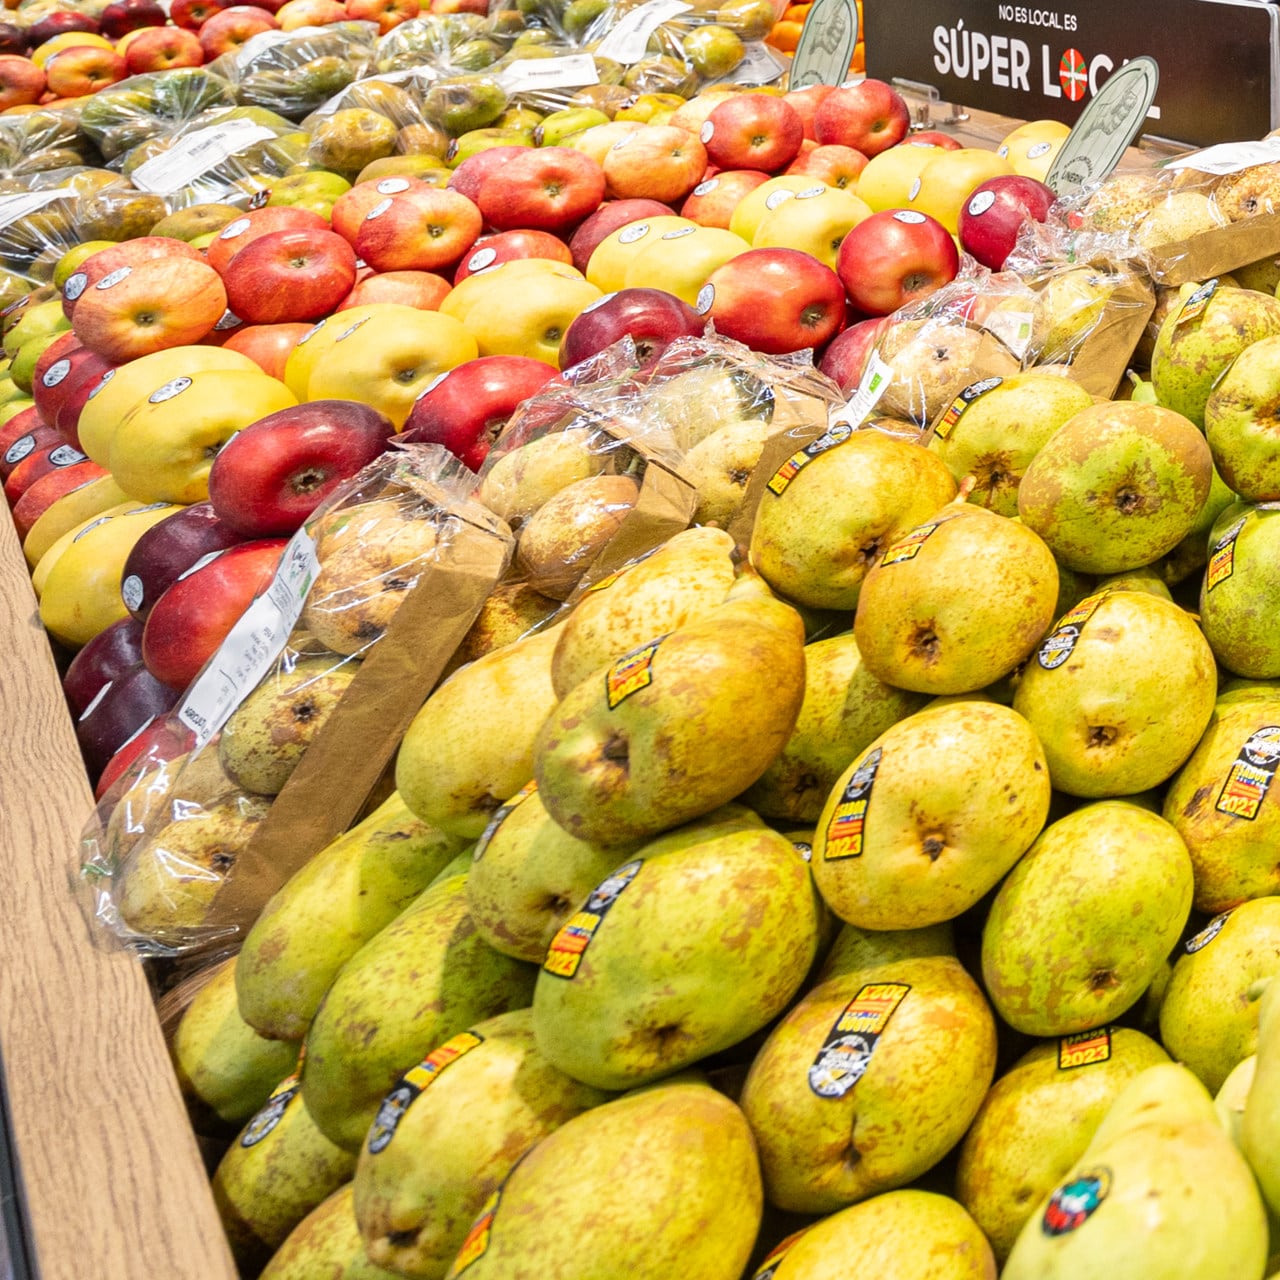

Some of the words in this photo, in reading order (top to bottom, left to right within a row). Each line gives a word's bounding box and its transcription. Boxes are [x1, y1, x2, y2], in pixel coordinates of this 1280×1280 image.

[999, 4, 1015, 21] NO
[1015, 6, 1028, 23] ES
[1028, 8, 1063, 31] LOCAL,
[1063, 13, 1078, 32] ES
[932, 20, 1030, 91] SÚPER
[1220, 794, 1258, 817] 2023
[825, 834, 862, 856] 2023
[1061, 1048, 1110, 1067] 2023
